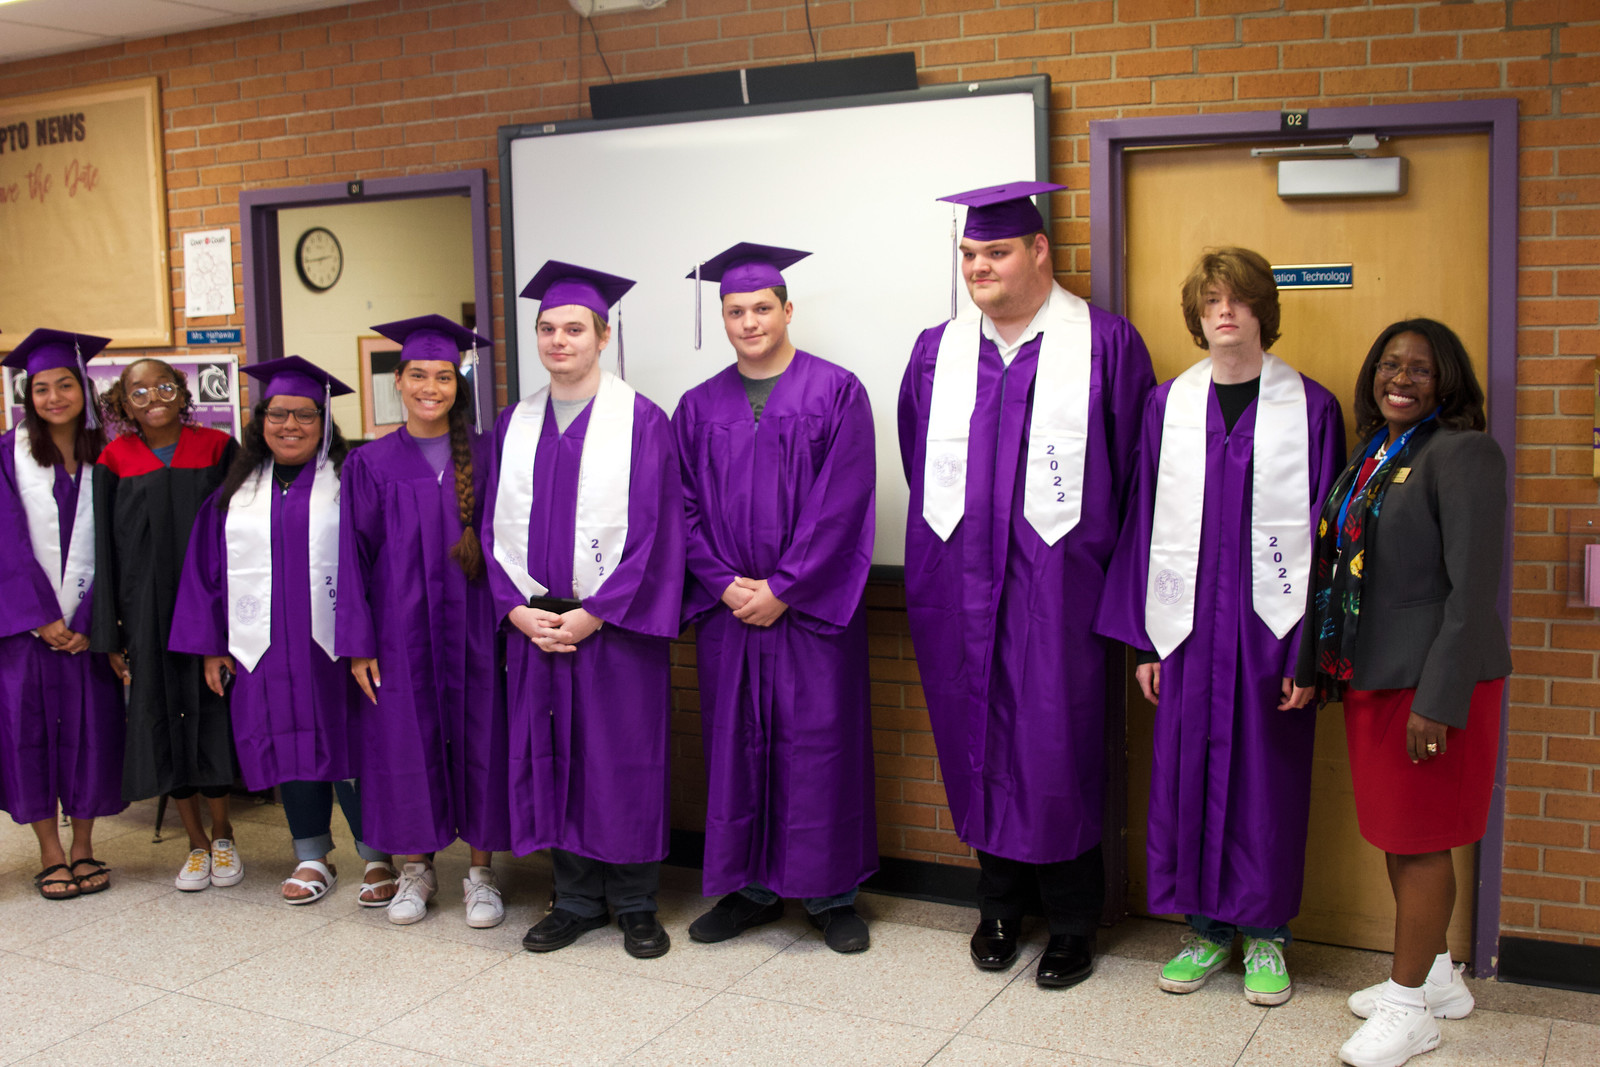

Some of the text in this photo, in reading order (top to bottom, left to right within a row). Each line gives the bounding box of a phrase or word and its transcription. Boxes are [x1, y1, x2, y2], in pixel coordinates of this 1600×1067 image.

[0, 112, 86, 155] PTO NEWS
[1287, 114, 1302, 126] 02
[24, 163, 53, 203] the
[64, 158, 99, 198] Date
[1301, 270, 1351, 283] Technology
[1046, 444, 1066, 503] 2022
[1269, 536, 1292, 594] 2022
